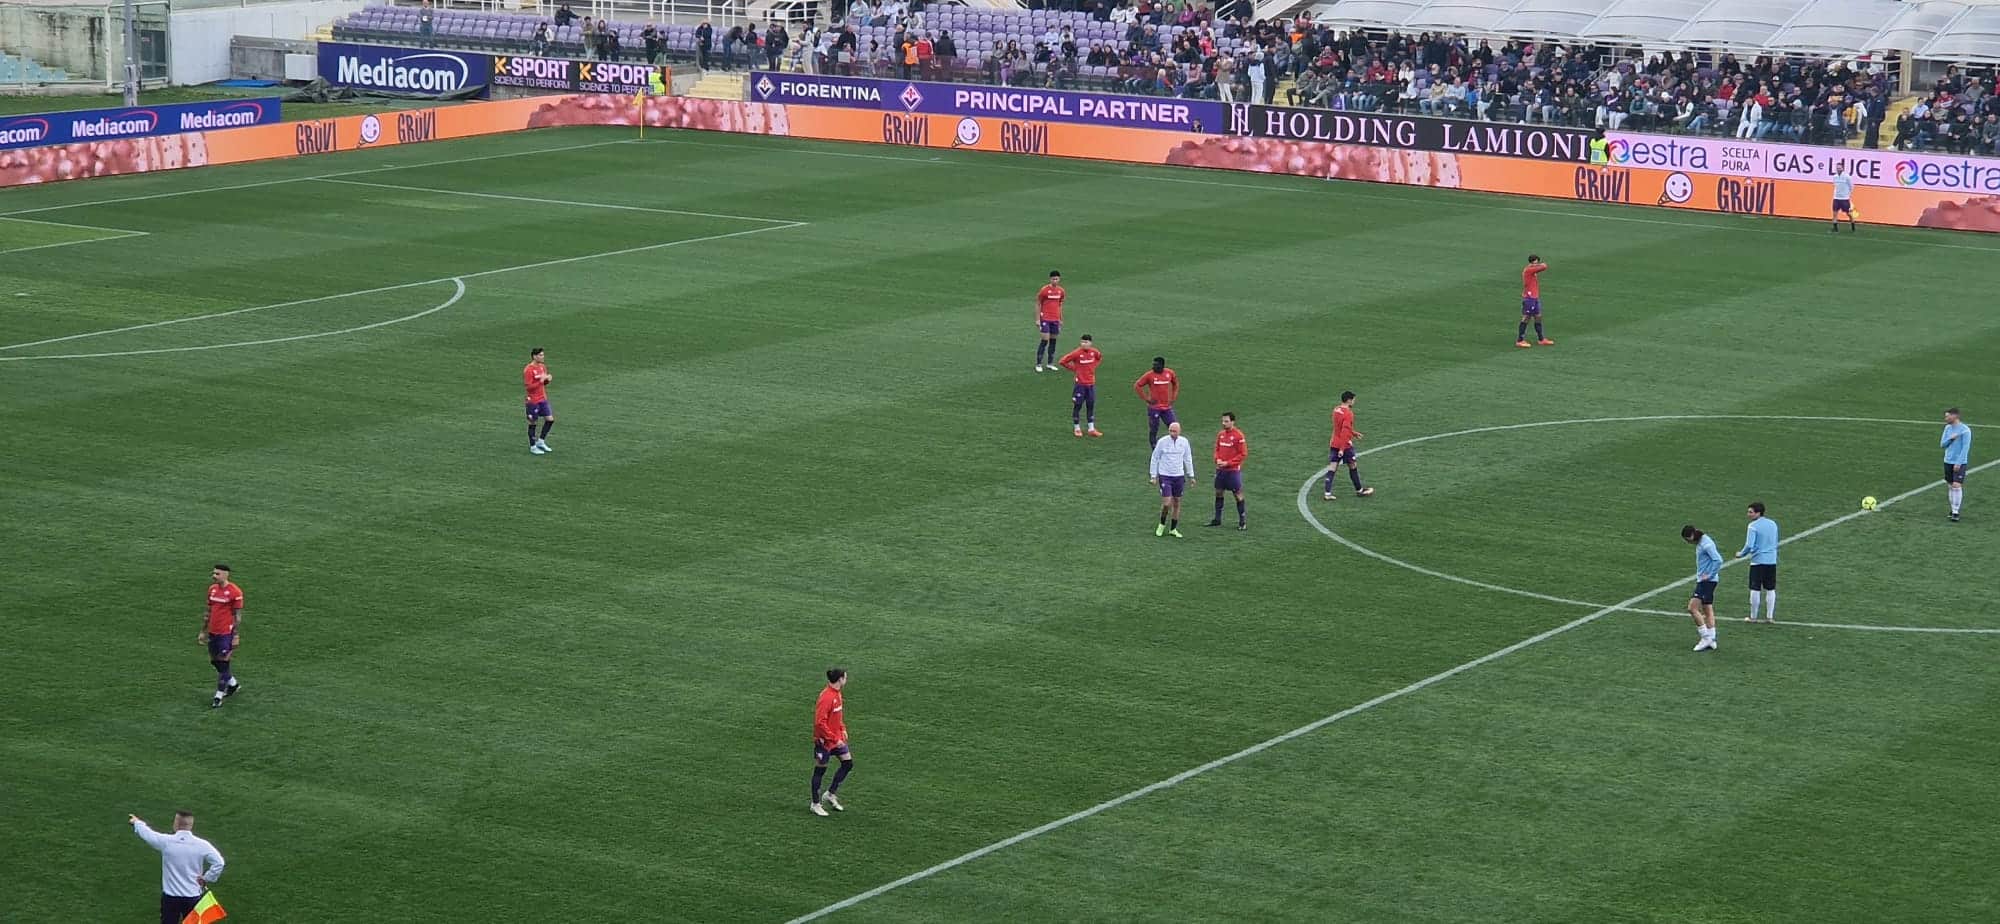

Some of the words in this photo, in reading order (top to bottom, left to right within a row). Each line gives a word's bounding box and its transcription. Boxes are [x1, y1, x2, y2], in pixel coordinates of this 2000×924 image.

[338, 55, 456, 91] Mediacom
[494, 56, 569, 80] K-SPORT
[579, 62, 654, 85] K-SPORT
[494, 76, 526, 86] SCIENCE
[526, 77, 535, 87] TO
[536, 78, 570, 90] PERFORM
[579, 82, 610, 92] SCIENCE
[611, 83, 620, 93] TO
[780, 82, 881, 101] FIORENTINA
[955, 91, 1073, 116] PRINCIPAL
[1079, 100, 1189, 124] PARTNER
[72, 118, 149, 138] Mediacom
[181, 110, 254, 129] Mediacom
[0, 127, 41, 144] acom
[1266, 111, 1416, 146] HOLDING
[1442, 124, 1588, 160] LAMIONI
[1632, 139, 1709, 169] estra
[1722, 147, 1760, 160] SCELTA
[1773, 153, 1814, 174] GAS
[1818, 161, 1825, 170] e
[1722, 160, 1750, 171] PURA
[1921, 160, 2000, 190] estra
